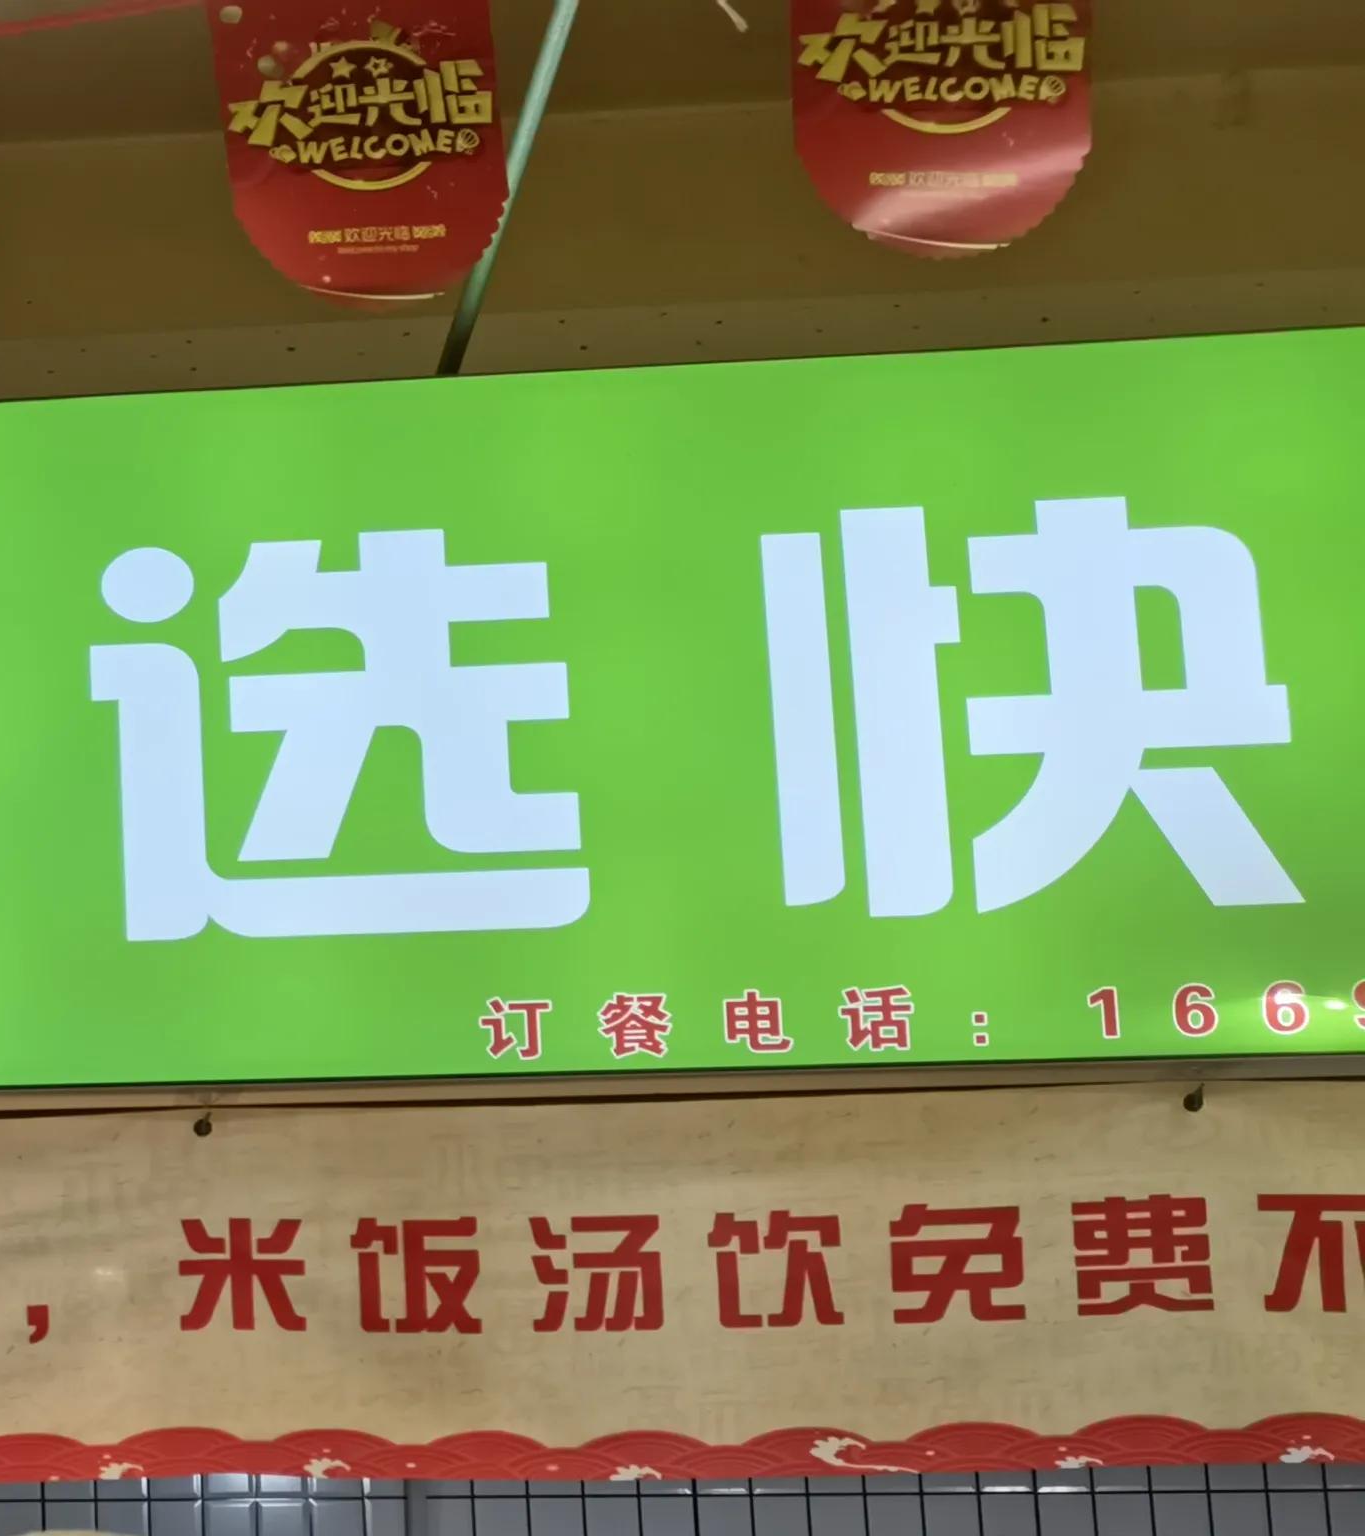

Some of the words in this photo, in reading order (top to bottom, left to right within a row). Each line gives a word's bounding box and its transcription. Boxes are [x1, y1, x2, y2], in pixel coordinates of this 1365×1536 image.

[798, 3, 1085, 82] 欢迎光临
[227, 59, 492, 147] 欢迎光临
[867, 74, 1040, 103] WELCOME
[297, 129, 457, 164] WELCOME
[479, 986, 987, 1059] 订餐电话：
